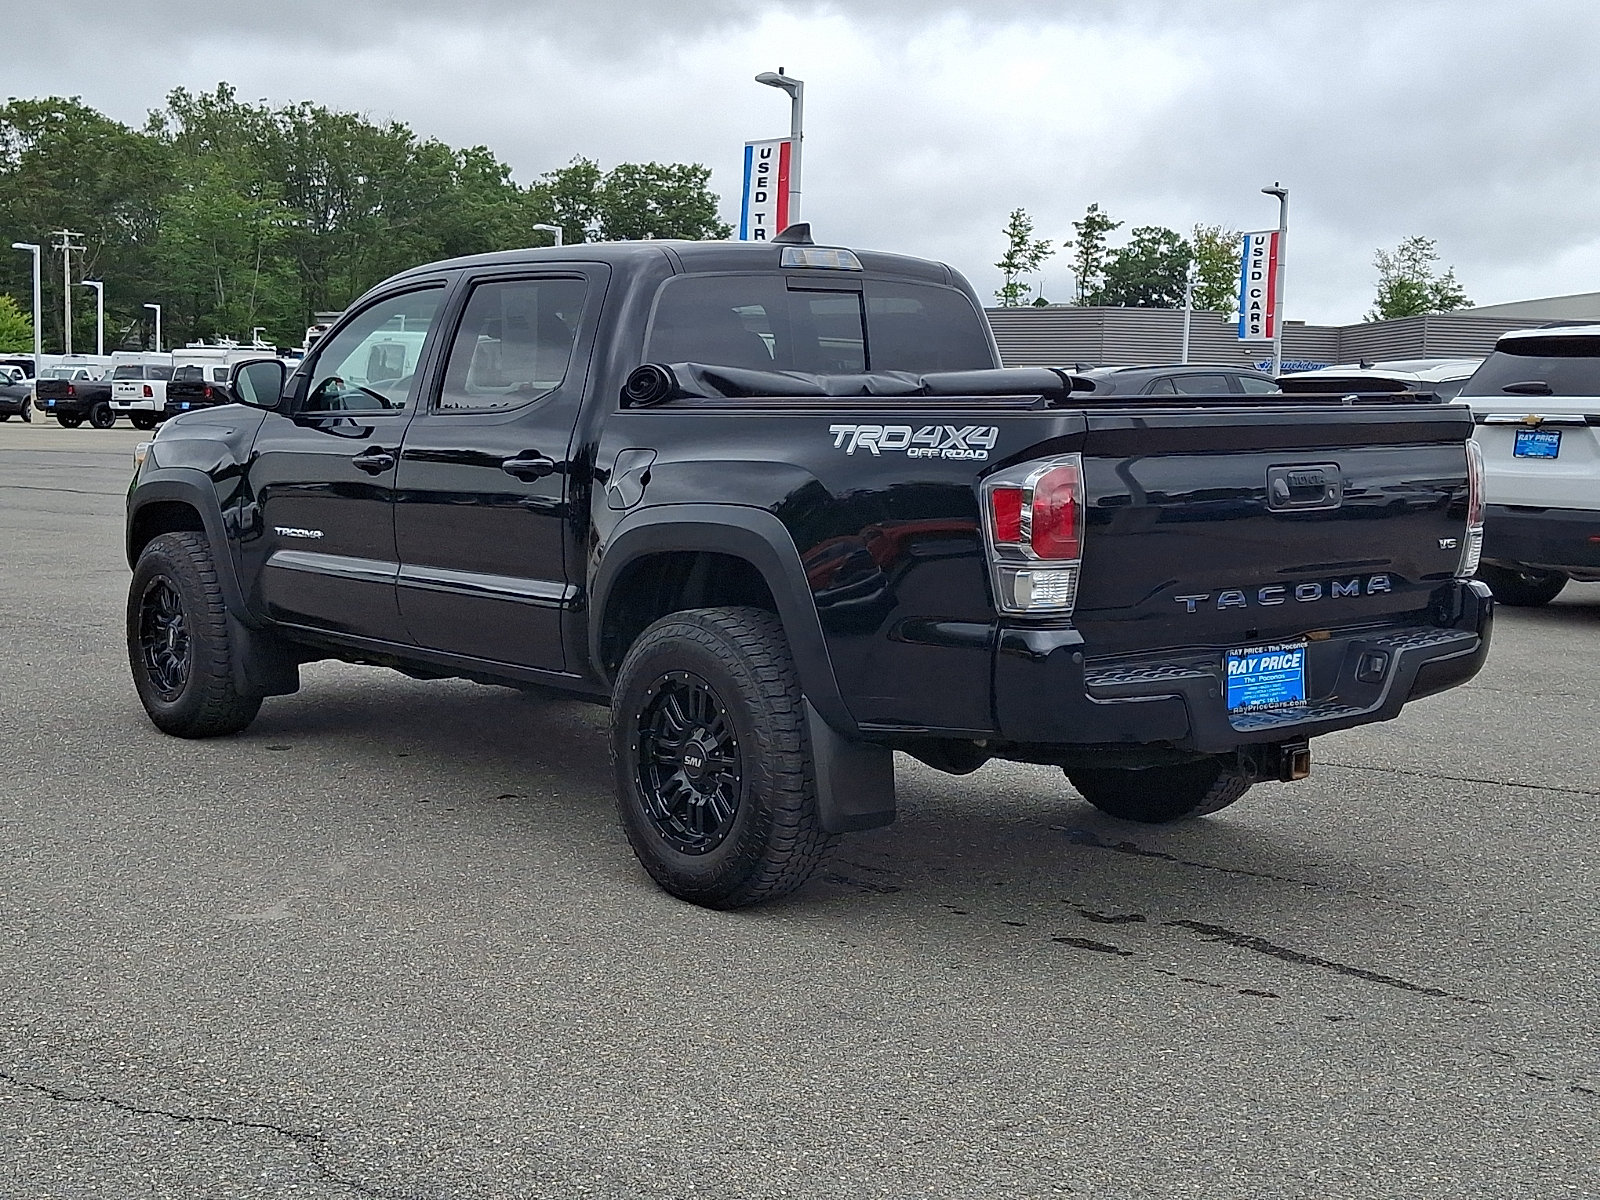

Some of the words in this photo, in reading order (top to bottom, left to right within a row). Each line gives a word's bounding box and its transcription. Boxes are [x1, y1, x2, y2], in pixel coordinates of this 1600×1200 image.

[755, 148, 772, 203] USED
[1251, 236, 1265, 281] USED
[1250, 288, 1262, 334] CARS
[829, 425, 913, 457] TRD
[1535, 434, 1560, 442] PRICE
[906, 448, 940, 460] OFF
[940, 449, 989, 461] ROAD
[274, 526, 325, 539] TACOMA
[1438, 538, 1457, 549] V6
[1174, 575, 1392, 613] TACOMA
[1244, 647, 1263, 655] PRICE
[1268, 645, 1280, 653] The
[1281, 642, 1308, 651] Poconos
[1228, 658, 1258, 675] RAY
[1260, 653, 1302, 672] PRICE
[1259, 674, 1286, 682] Poconos
[1233, 700, 1307, 713] RayPriceCars.com
